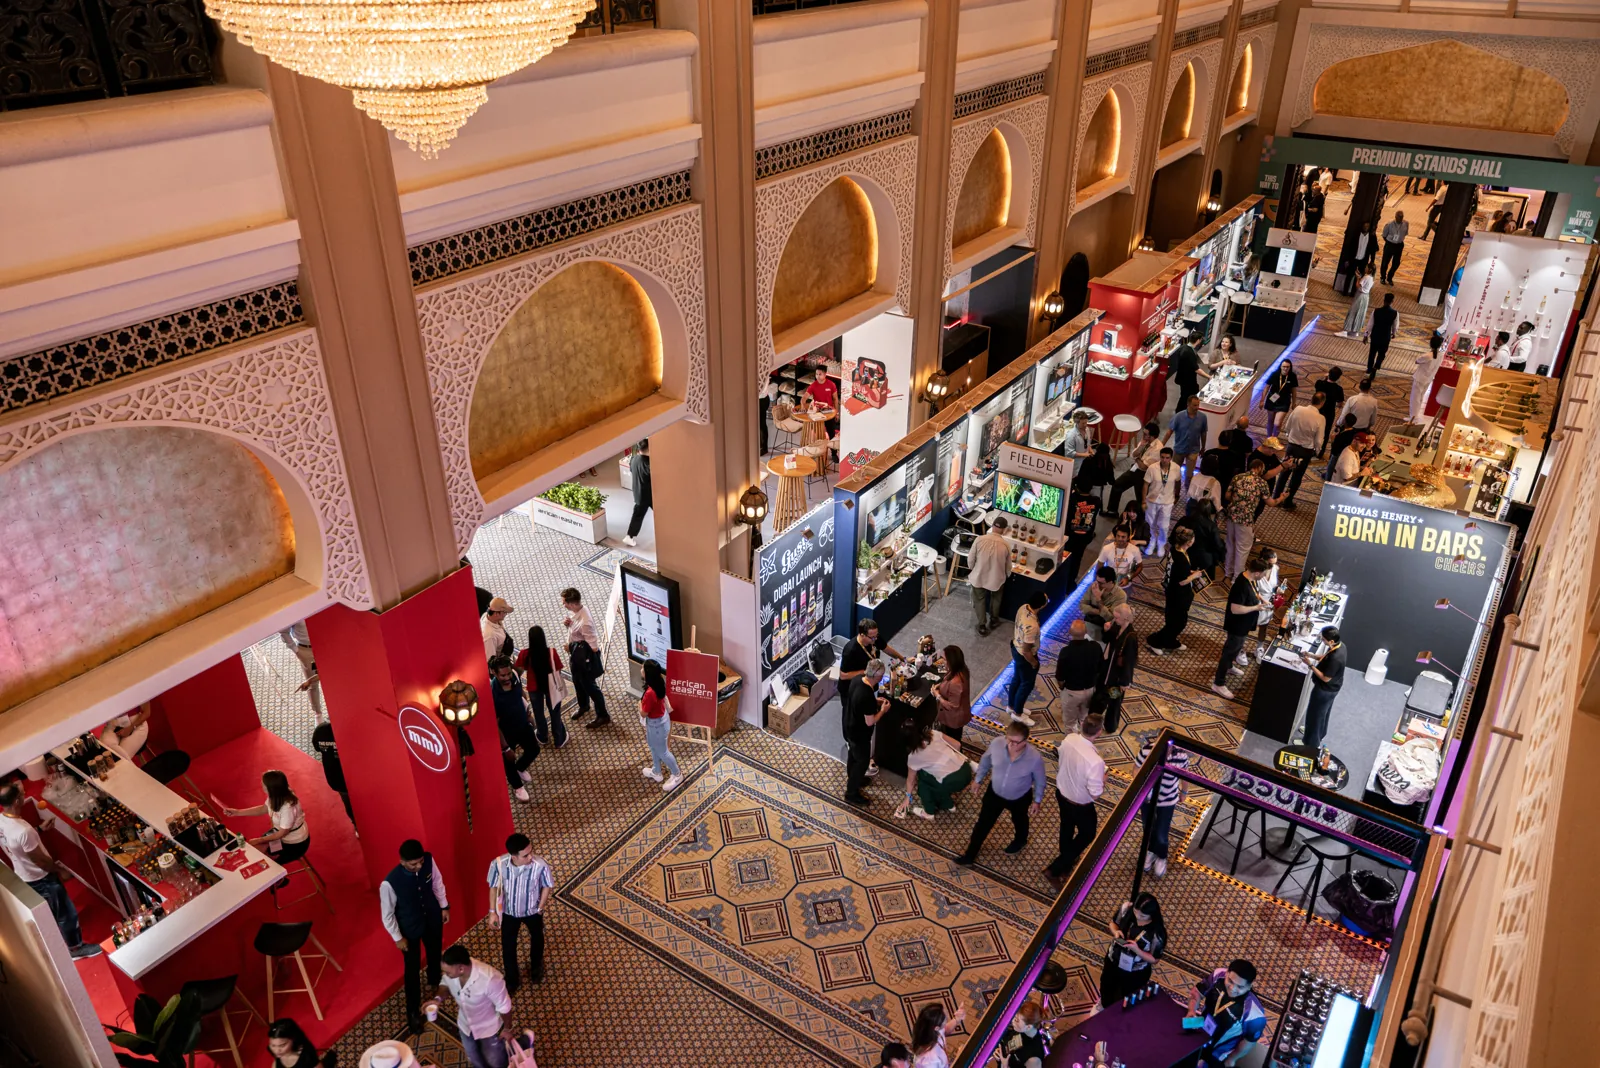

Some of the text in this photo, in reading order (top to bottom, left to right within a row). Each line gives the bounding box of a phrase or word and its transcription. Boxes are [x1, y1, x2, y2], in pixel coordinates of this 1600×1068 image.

[1351, 147, 1502, 179] PREMIUM STANDS HALL
[1259, 181, 1280, 190] WAY TO
[1264, 174, 1277, 182] THIS
[1568, 217, 1594, 227] WAY TO
[1576, 210, 1592, 219] THIS
[1009, 451, 1064, 475] FIELDEN
[1338, 504, 1418, 524] THOMAS HENRY
[1334, 513, 1487, 562] BORN IN BARS.
[1434, 556, 1486, 577] CHEERS
[773, 576, 795, 603] DUBAI
[795, 555, 822, 586] LAUNCH
[670, 679, 706, 690] african
